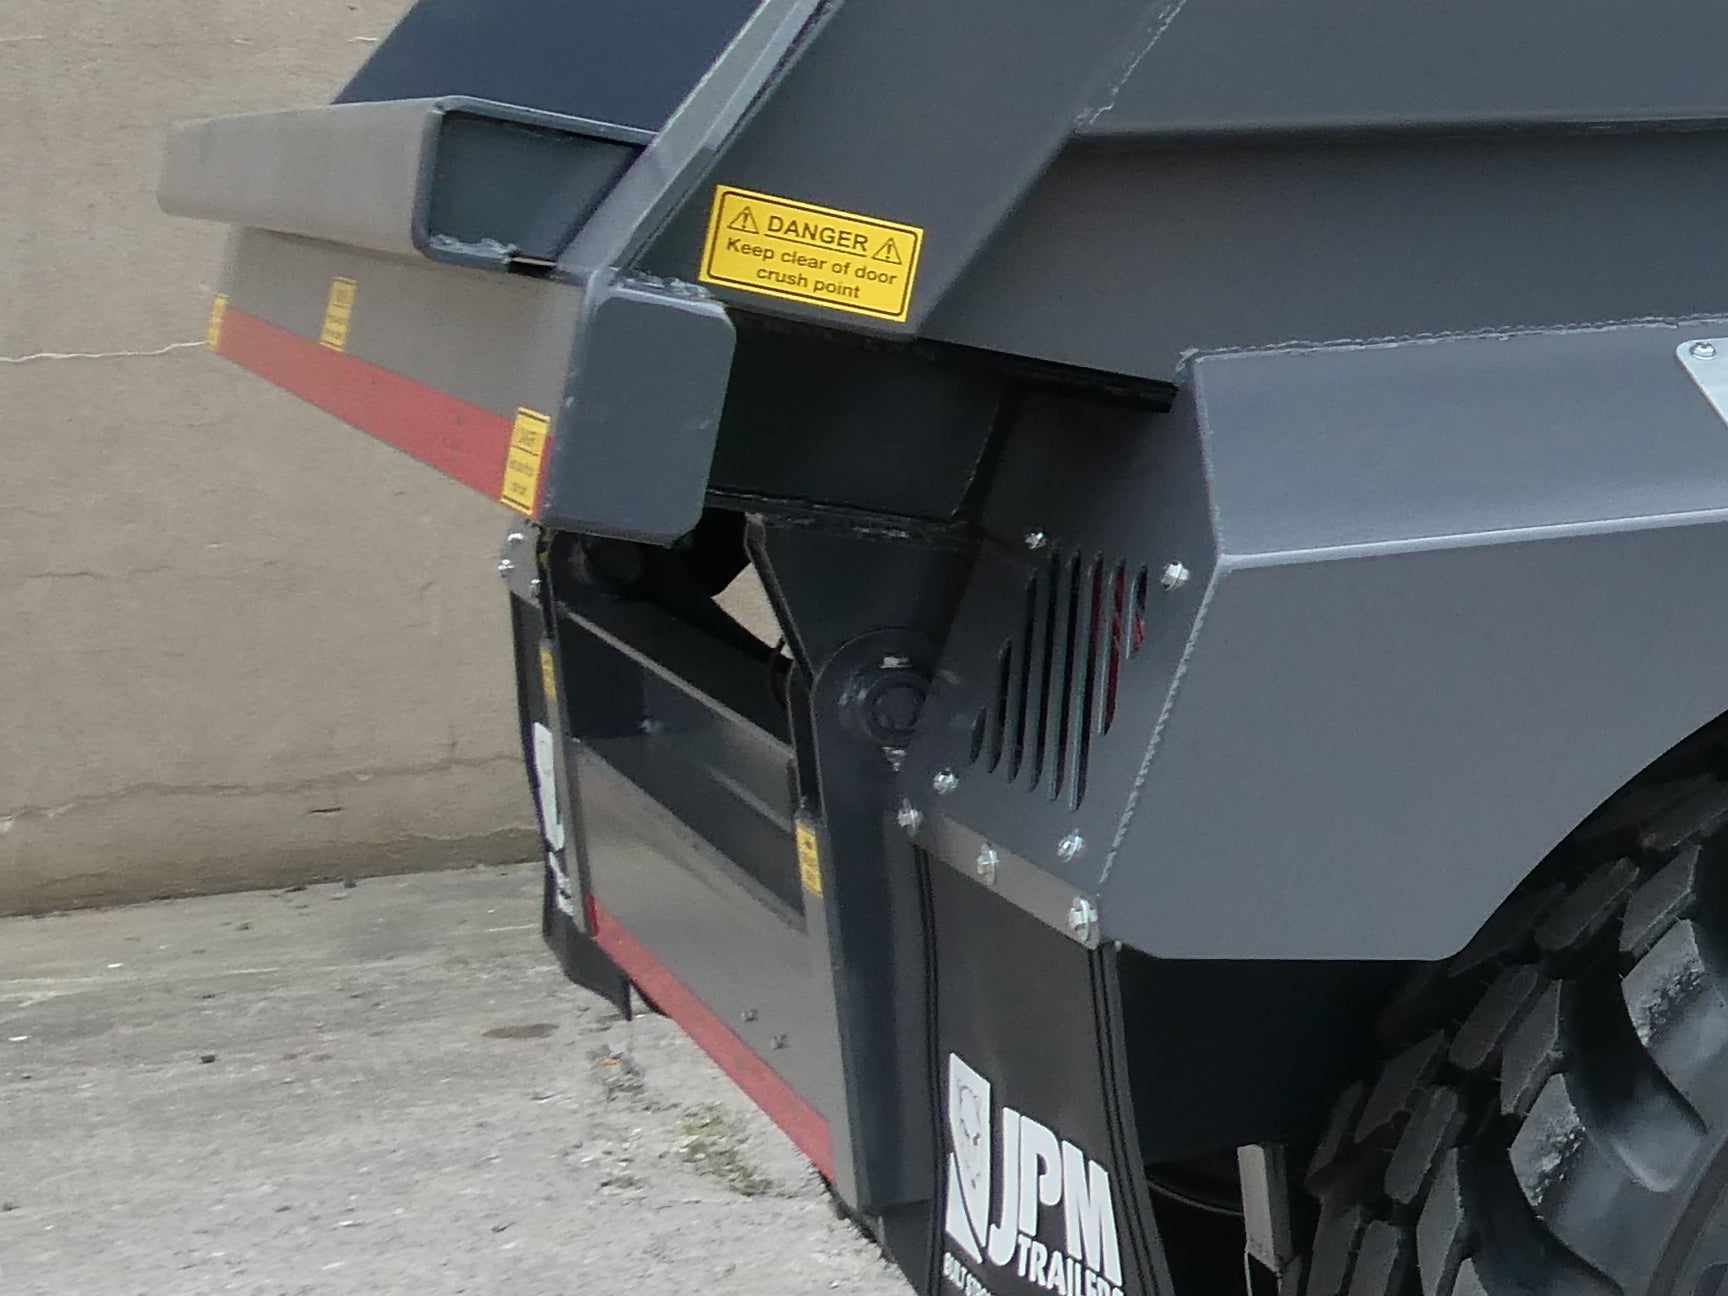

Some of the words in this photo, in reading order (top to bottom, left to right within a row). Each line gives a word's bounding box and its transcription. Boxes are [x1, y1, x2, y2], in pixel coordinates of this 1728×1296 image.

[767, 215, 869, 252] DANGER
[726, 237, 775, 262] Keep
[781, 250, 826, 271] clear
[831, 262, 853, 275] of
[854, 265, 898, 285] door
[756, 267, 808, 288] crush
[813, 280, 861, 300] point
[988, 1106, 1123, 1287] JPM
